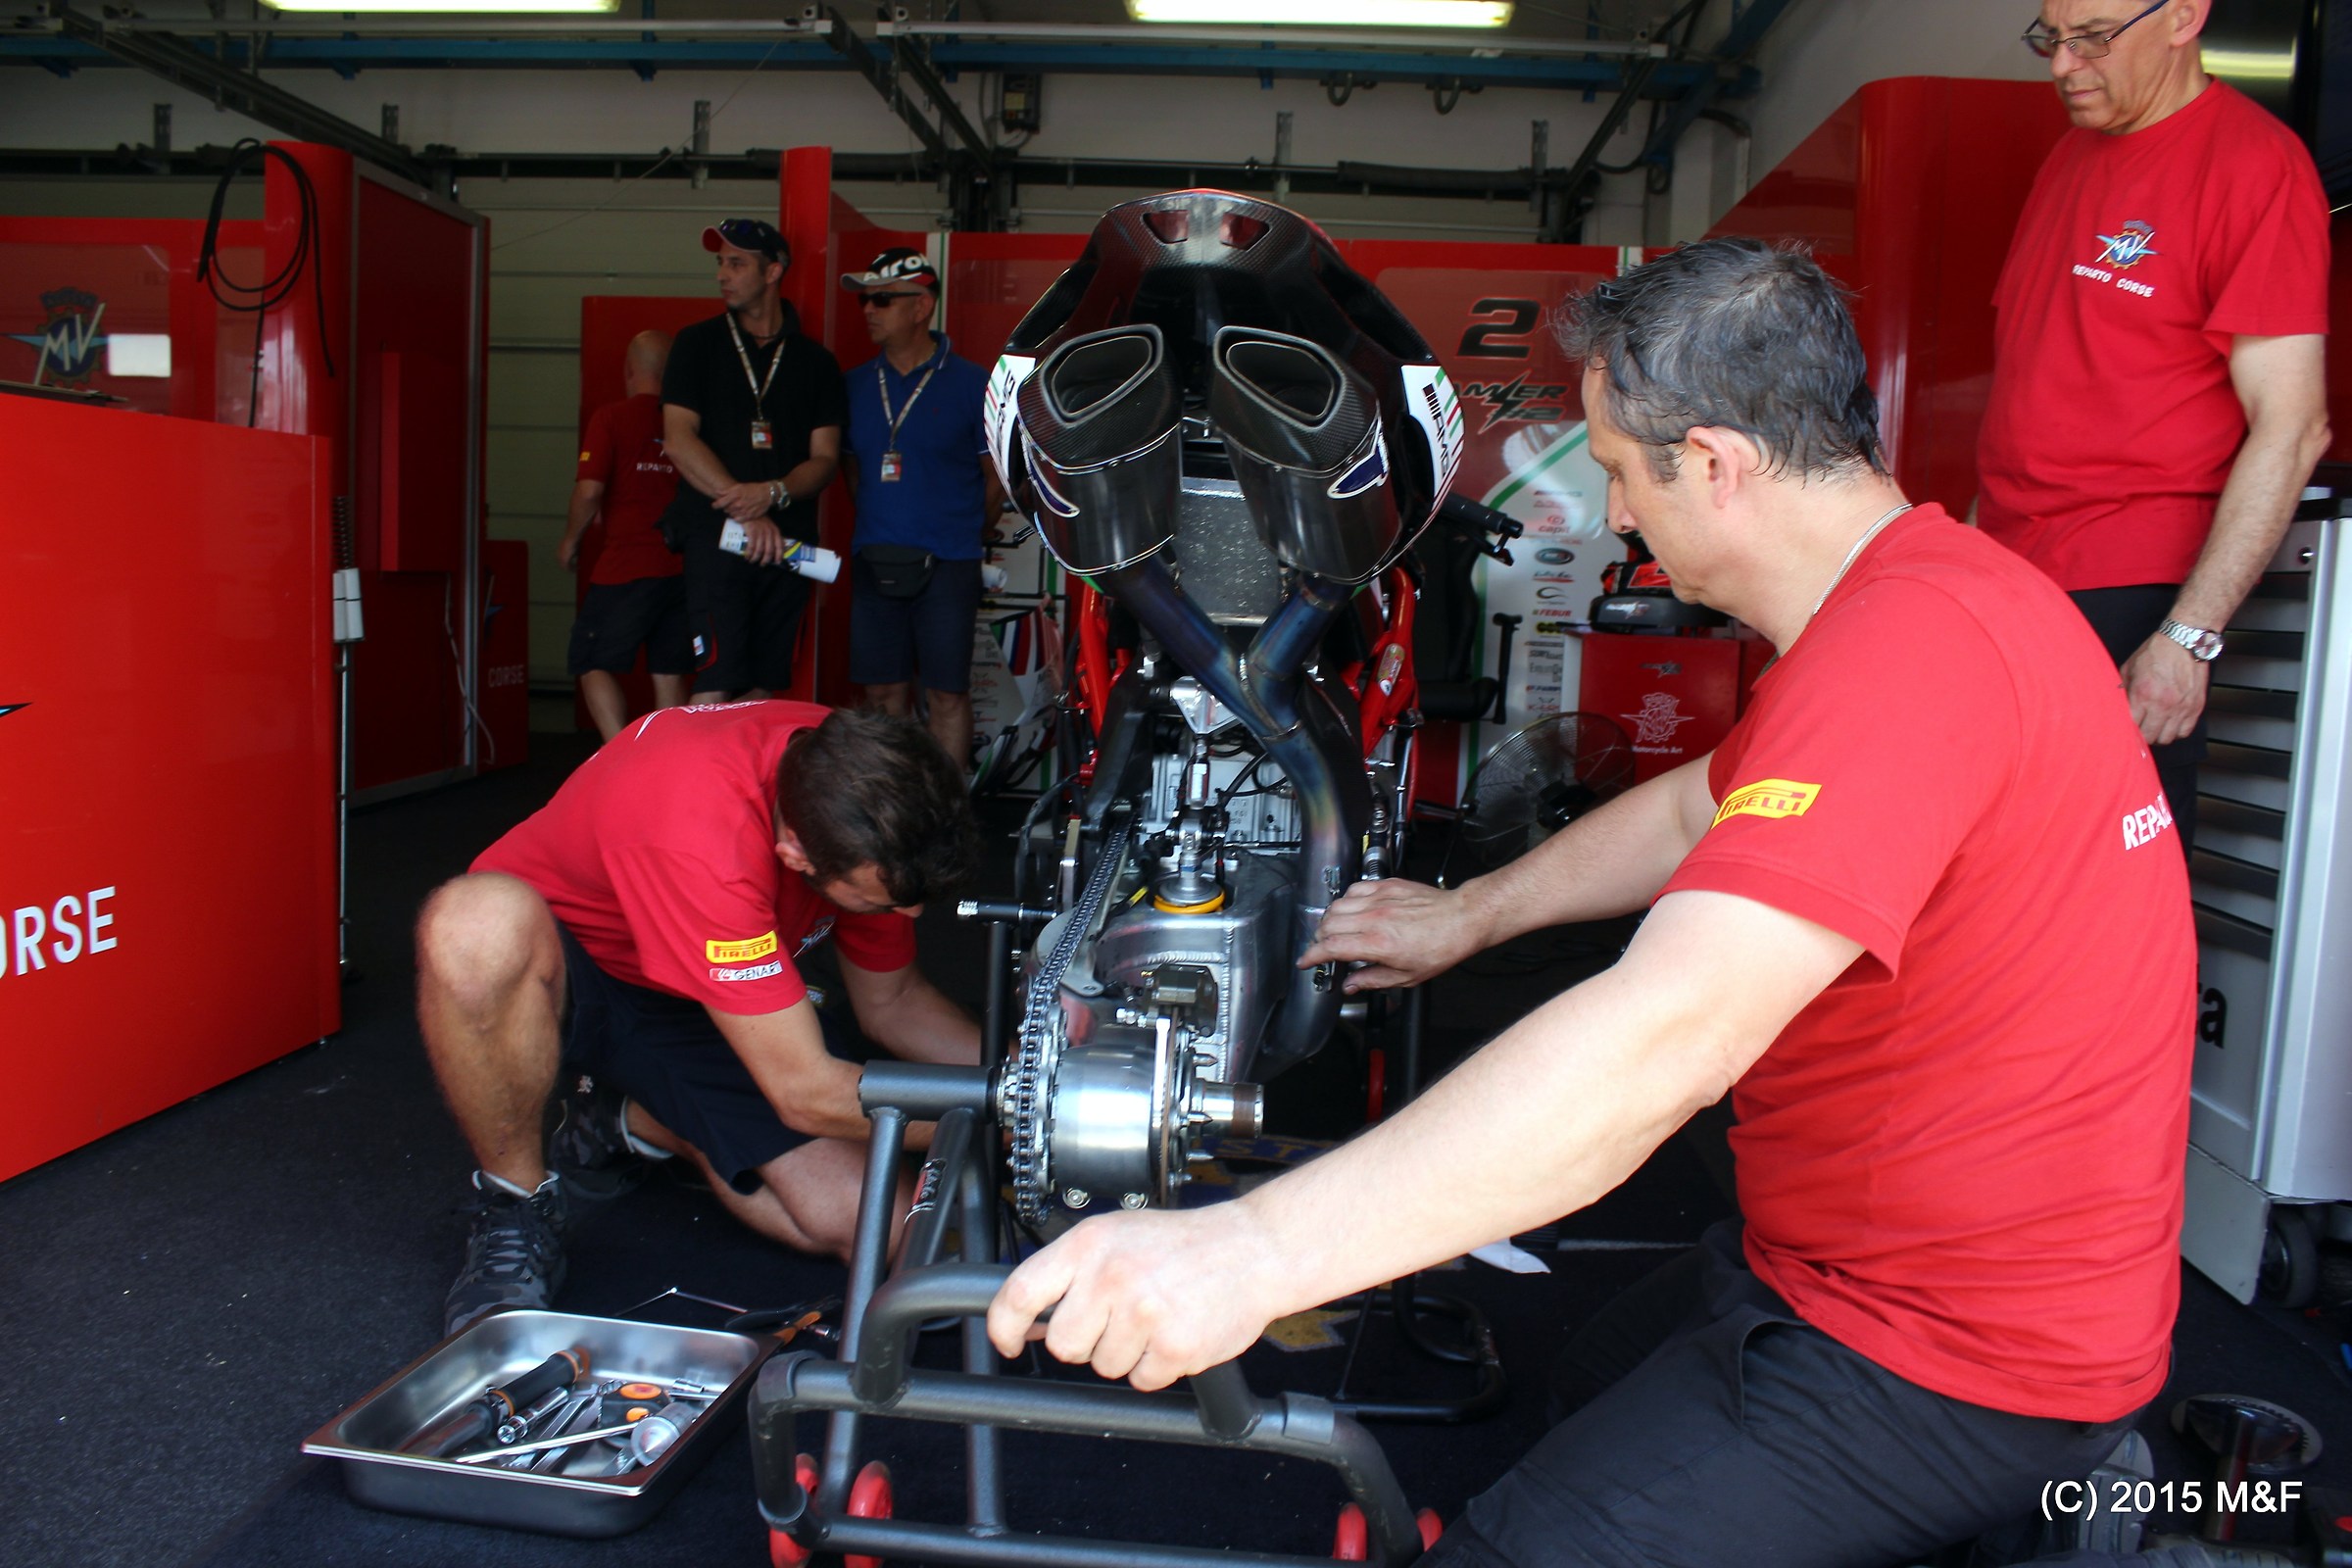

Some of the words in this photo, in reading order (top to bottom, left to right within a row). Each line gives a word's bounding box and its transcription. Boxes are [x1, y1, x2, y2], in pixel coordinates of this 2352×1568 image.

[2072, 265, 2112, 283] REPARTO
[2116, 278, 2155, 298] CORSE
[1457, 297, 1541, 359] 2
[1718, 787, 1807, 821] PIRELLI
[0, 886, 118, 979] RSE
[713, 938, 771, 958] PIRELLI
